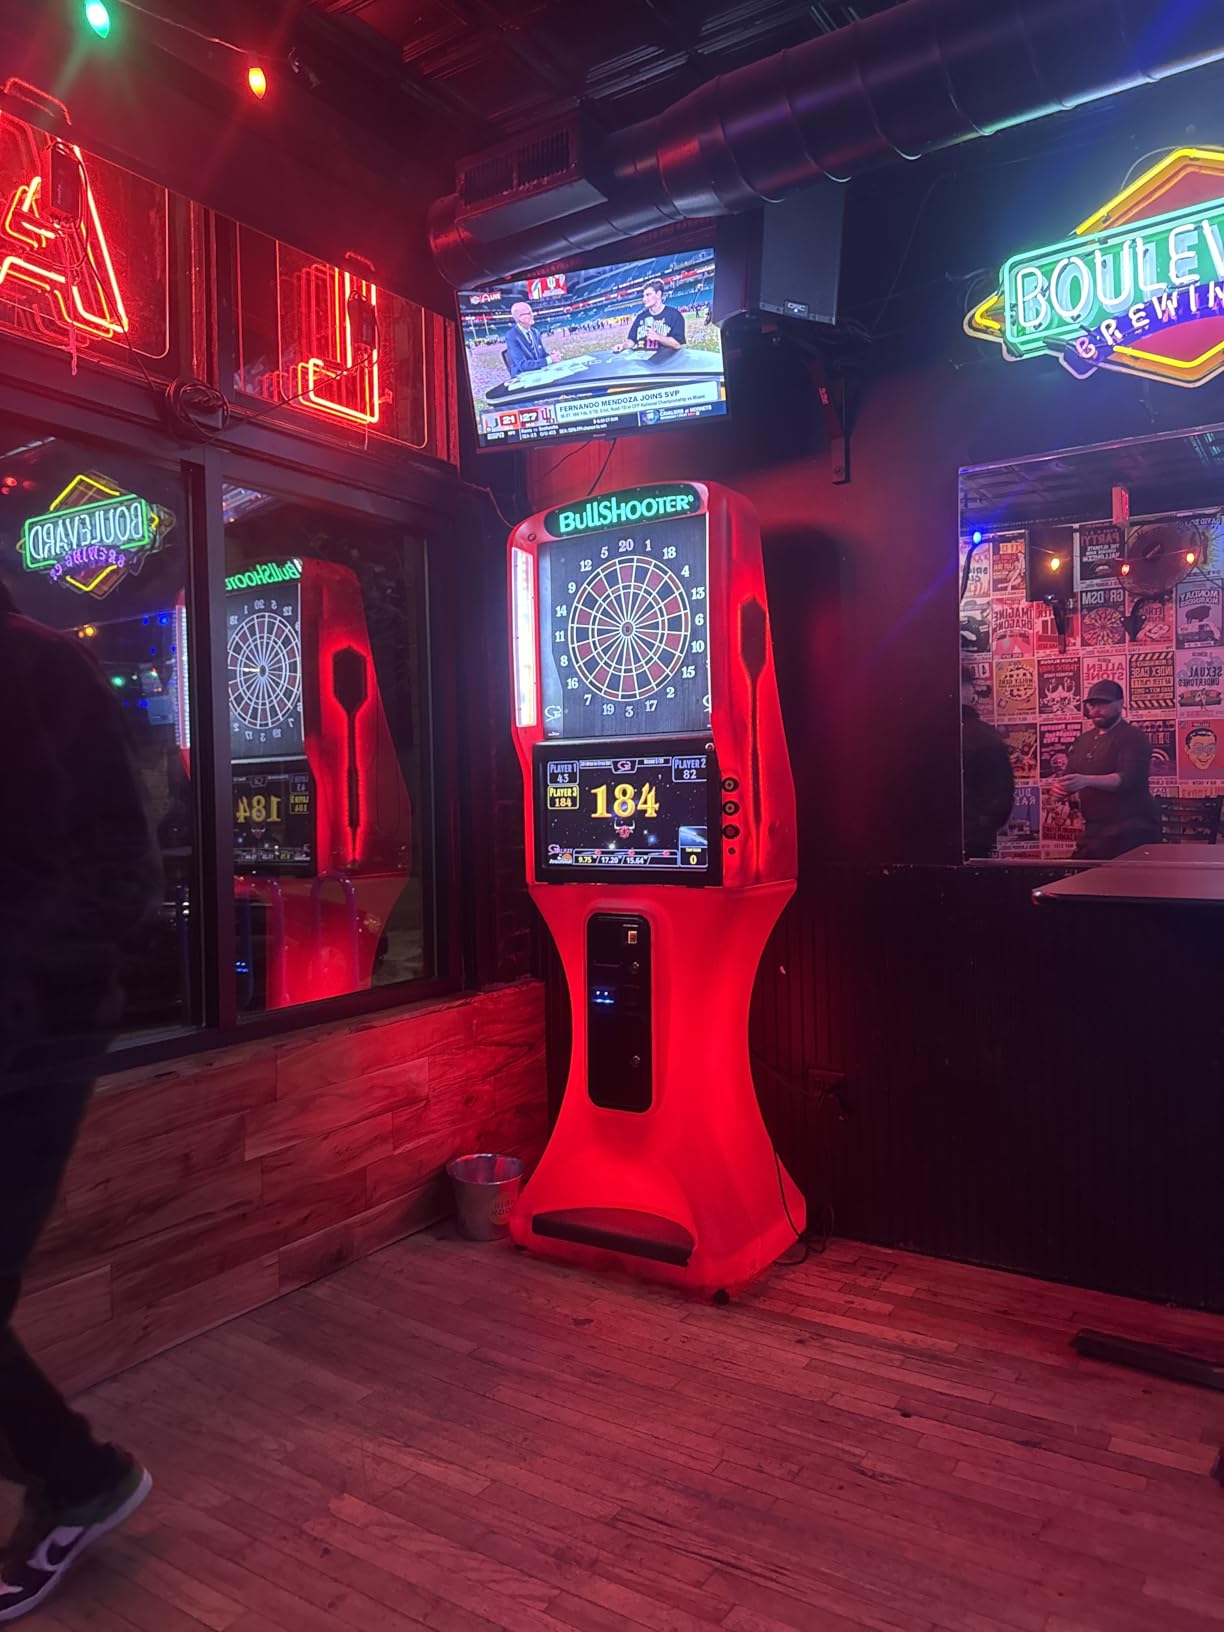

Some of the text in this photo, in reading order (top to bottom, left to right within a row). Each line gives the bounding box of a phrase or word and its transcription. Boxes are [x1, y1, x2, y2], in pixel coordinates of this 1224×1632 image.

[559, 390, 680, 413] FERNANDO MENDOZA JOINS SVP
[502, 415, 515, 424] 21
[522, 412, 537, 422] 27
[618, 539, 634, 552] 20
[645, 539, 652, 551] 1
[600, 547, 608, 559] 5
[662, 547, 676, 559] 18
[580, 559, 592, 572] 12
[681, 565, 690, 577] 4
[568, 582, 576, 593] 9
[691, 586, 705, 600] 13
[555, 606, 567, 617] 14
[695, 614, 704, 626] 6
[555, 631, 565, 642] 11
[691, 640, 704, 653] 10
[560, 655, 568, 666] 8
[682, 665, 695, 679] 15
[567, 677, 578, 689] 16
[666, 687, 675, 698] 2
[584, 694, 592, 706] 7
[645, 700, 658, 712] 17
[602, 704, 615, 715] 19
[625, 705, 634, 717] 3
[550, 764, 572, 773] PLAYER
[674, 758, 698, 769] PLAYER
[699, 758, 706, 768] 2
[557, 773, 569, 783] 43
[683, 769, 697, 779] 82
[549, 787, 572, 797] PLAYER
[555, 798, 572, 807] 184
[591, 783, 660, 819] 184
[689, 854, 697, 865] 0
